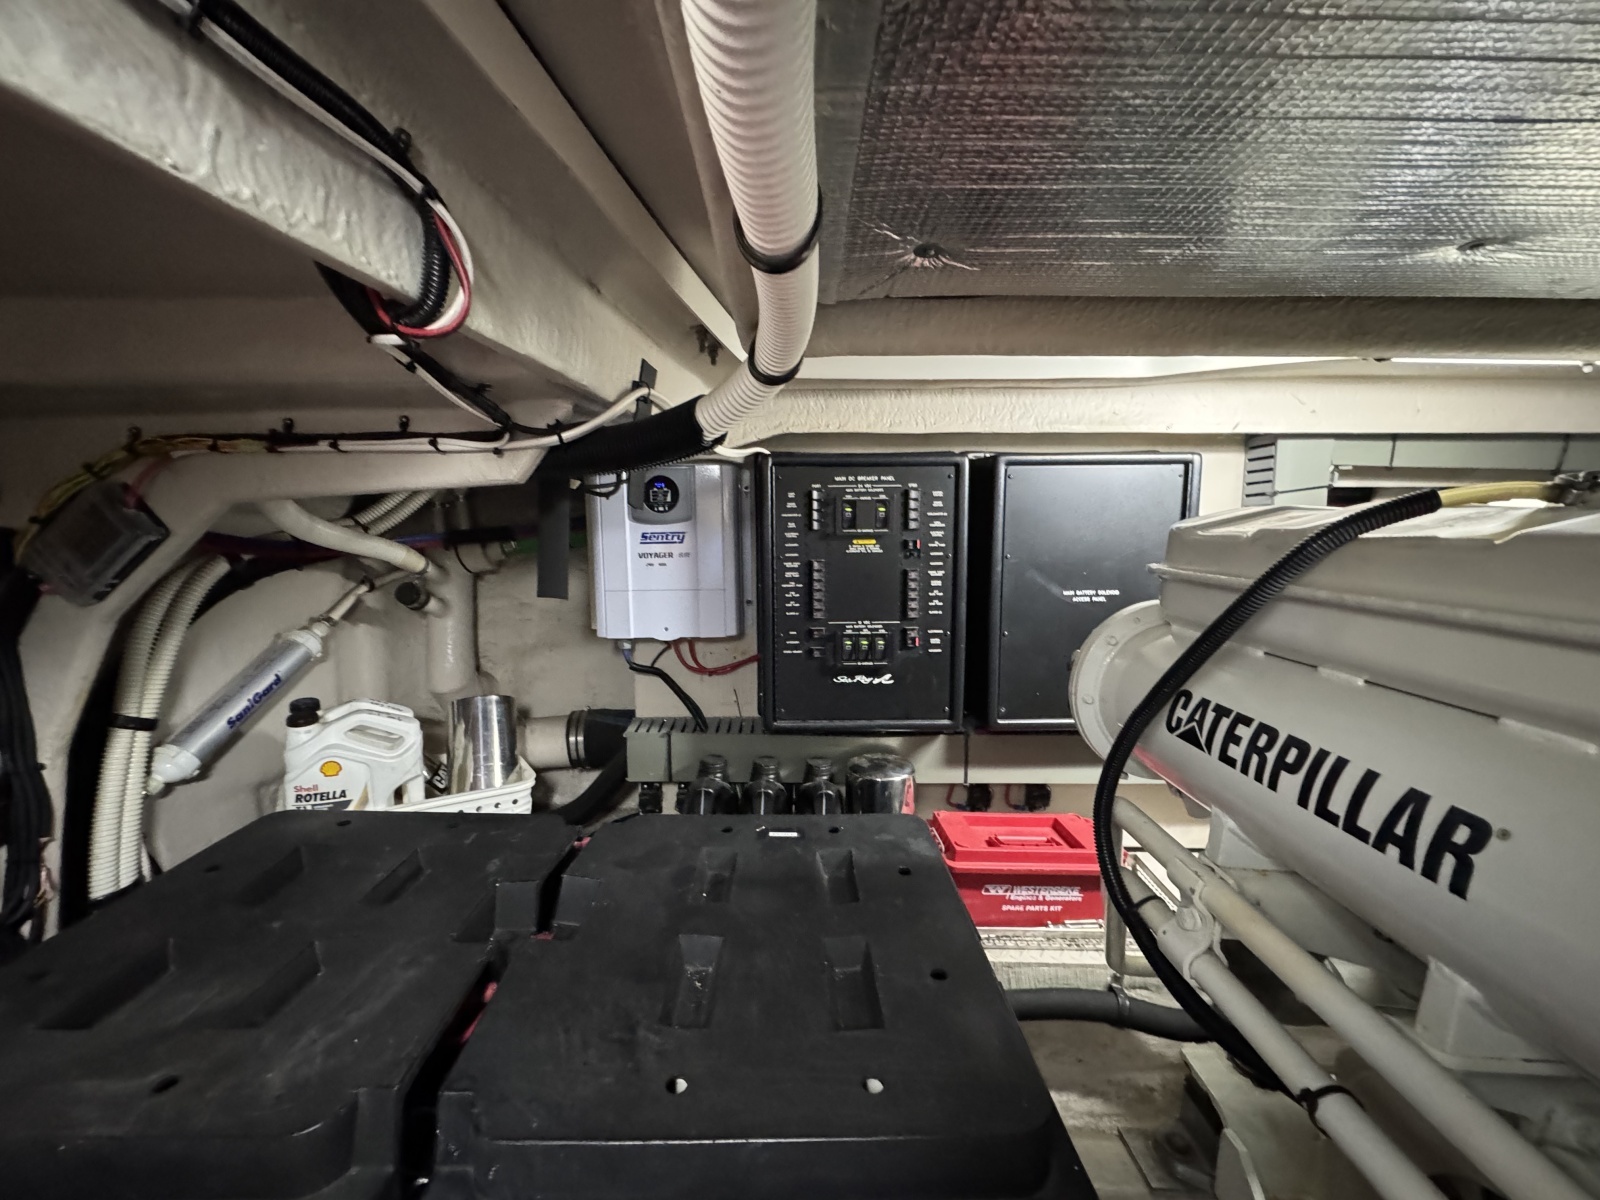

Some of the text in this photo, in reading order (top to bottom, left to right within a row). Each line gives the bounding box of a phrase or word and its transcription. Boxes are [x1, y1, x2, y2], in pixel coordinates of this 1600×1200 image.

[640, 532, 686, 545] Sentry
[227, 673, 281, 729] SaniGard
[294, 784, 319, 793] Shell
[295, 789, 347, 803] ROTELLA
[1165, 690, 1492, 901] CATERPILLAR
[1013, 885, 1082, 895] WESTERBEKE
[1045, 894, 1082, 902] Generators
